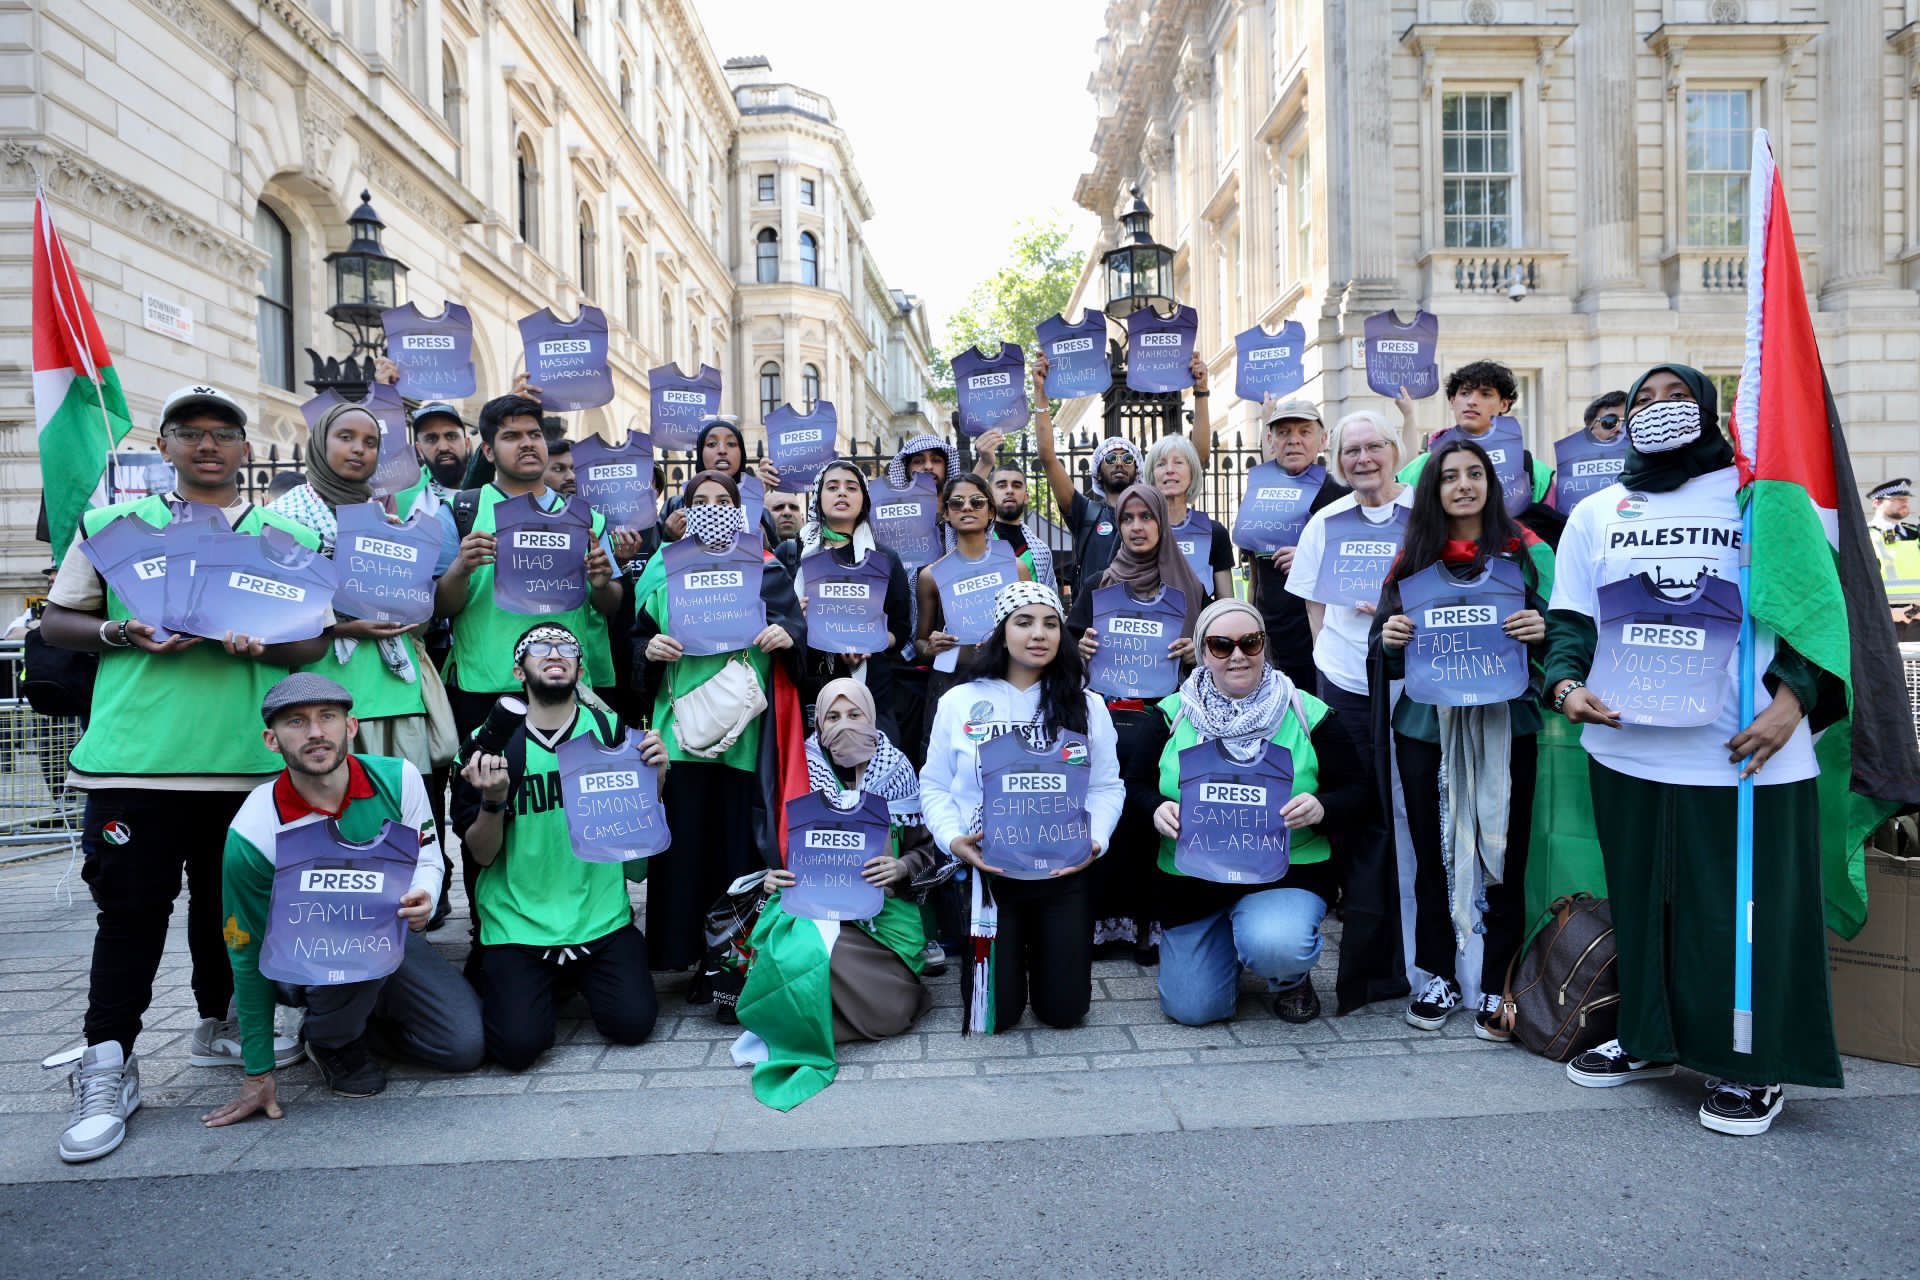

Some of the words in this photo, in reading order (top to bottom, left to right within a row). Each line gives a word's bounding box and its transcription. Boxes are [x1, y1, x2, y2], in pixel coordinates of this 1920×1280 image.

[148, 296, 181, 318] DOWNING
[149, 309, 174, 326] STREET
[407, 337, 451, 348] PRESS
[544, 341, 587, 354] PRESS
[1056, 340, 1090, 353] PRESS
[1143, 335, 1178, 345] PRESS
[1381, 342, 1415, 352] PRESS
[1253, 348, 1287, 359] PRESS
[541, 357, 584, 369] HASSAN
[972, 374, 1007, 387] PRESS
[667, 392, 703, 403] PRESS
[784, 431, 818, 443] PRESS
[777, 446, 824, 459] HUSSAM
[594, 466, 633, 478] PRESS
[1577, 461, 1622, 475] PRESS
[582, 481, 621, 497] IMAD
[1261, 489, 1299, 499] PRESS
[881, 505, 918, 518] PRESS
[1240, 520, 1304, 534] ZAQOUT
[519, 534, 566, 547] PRESS
[1611, 527, 1742, 550] PALESTINE
[362, 539, 413, 560] PRESS
[1345, 543, 1392, 555] PRESS
[350, 556, 412, 580] BAHAA
[512, 553, 554, 570] IHAB
[1333, 558, 1390, 577] IZZAT
[237, 575, 299, 599] PRESS
[525, 578, 581, 592] JAMAL
[690, 573, 738, 587] PRESS
[958, 575, 998, 593] PRESS
[345, 578, 430, 602] AL-GHARIB
[824, 585, 866, 597] PRESS
[816, 603, 867, 615] JAMES
[1431, 607, 1491, 625] PRESS
[825, 621, 876, 633] MILLER
[1114, 620, 1158, 635] PRESS
[1103, 635, 1147, 651] SHADI
[1417, 632, 1482, 655] FADEL
[1630, 627, 1698, 646] PRESS
[1114, 652, 1157, 669] HAMDI
[1608, 648, 1716, 676] YOUSSEF
[1101, 667, 1138, 685] AYAD
[1628, 675, 1667, 691] ABU
[1600, 689, 1707, 713] HUSSEIN
[586, 774, 634, 791] PRESS
[1008, 776, 1061, 790] PRESS
[1206, 786, 1261, 802] PRESS
[577, 792, 651, 817] SIMONE
[993, 795, 1080, 816] SHIREEN
[1192, 806, 1268, 829] SAMEH
[583, 815, 653, 841] CAMELLI
[994, 825, 1030, 846] ABU
[1038, 822, 1088, 843] AQLEH
[811, 832, 860, 848] PRESS
[1189, 833, 1285, 853] AL-ARIAN
[792, 851, 863, 868] MUHAMMAD
[308, 873, 377, 890] PRESS
[801, 873, 817, 887] AL
[825, 873, 852, 888] DIRI
[288, 902, 376, 924] JAMIL
[294, 935, 391, 958] NAWARA
